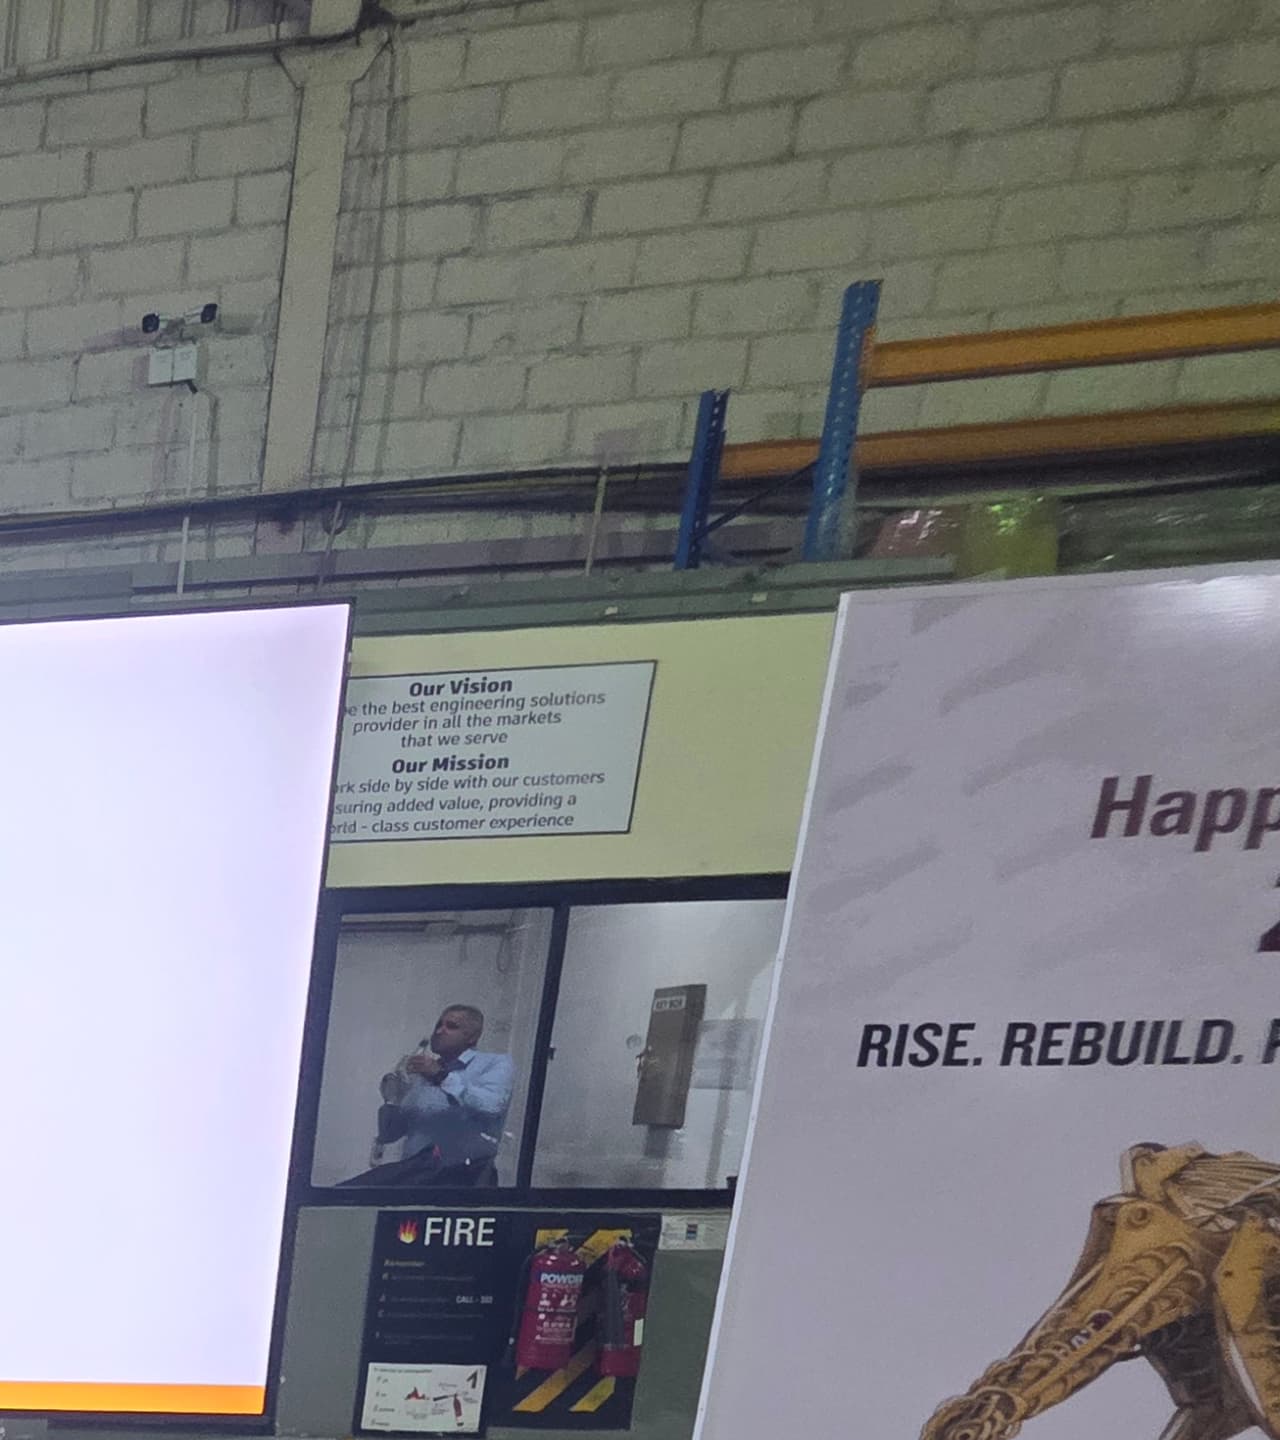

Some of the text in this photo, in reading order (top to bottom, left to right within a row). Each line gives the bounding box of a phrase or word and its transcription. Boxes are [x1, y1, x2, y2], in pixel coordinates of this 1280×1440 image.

[409, 677, 512, 697] Our Vision
[362, 702, 387, 716] the
[392, 701, 425, 714] best
[430, 696, 525, 715] engineering
[530, 691, 606, 707] solutions
[353, 711, 562, 736] provider in all the markets
[401, 732, 508, 748] that we serve
[392, 754, 509, 774] Our Mission
[359, 779, 390, 793] side
[395, 778, 413, 795] by
[417, 776, 449, 791] side
[453, 775, 487, 789] with
[492, 776, 519, 788] our
[523, 772, 605, 786] customers
[387, 798, 434, 812] added
[438, 797, 484, 811] value,
[489, 793, 563, 812] providing
[567, 795, 577, 806] a
[372, 820, 409, 833] class
[413, 818, 485, 831] customer
[489, 814, 574, 830] experience
[856, 1022, 982, 1067] RISE.
[999, 1019, 1244, 1066] REBUILD.
[424, 1217, 496, 1247] FIRE
